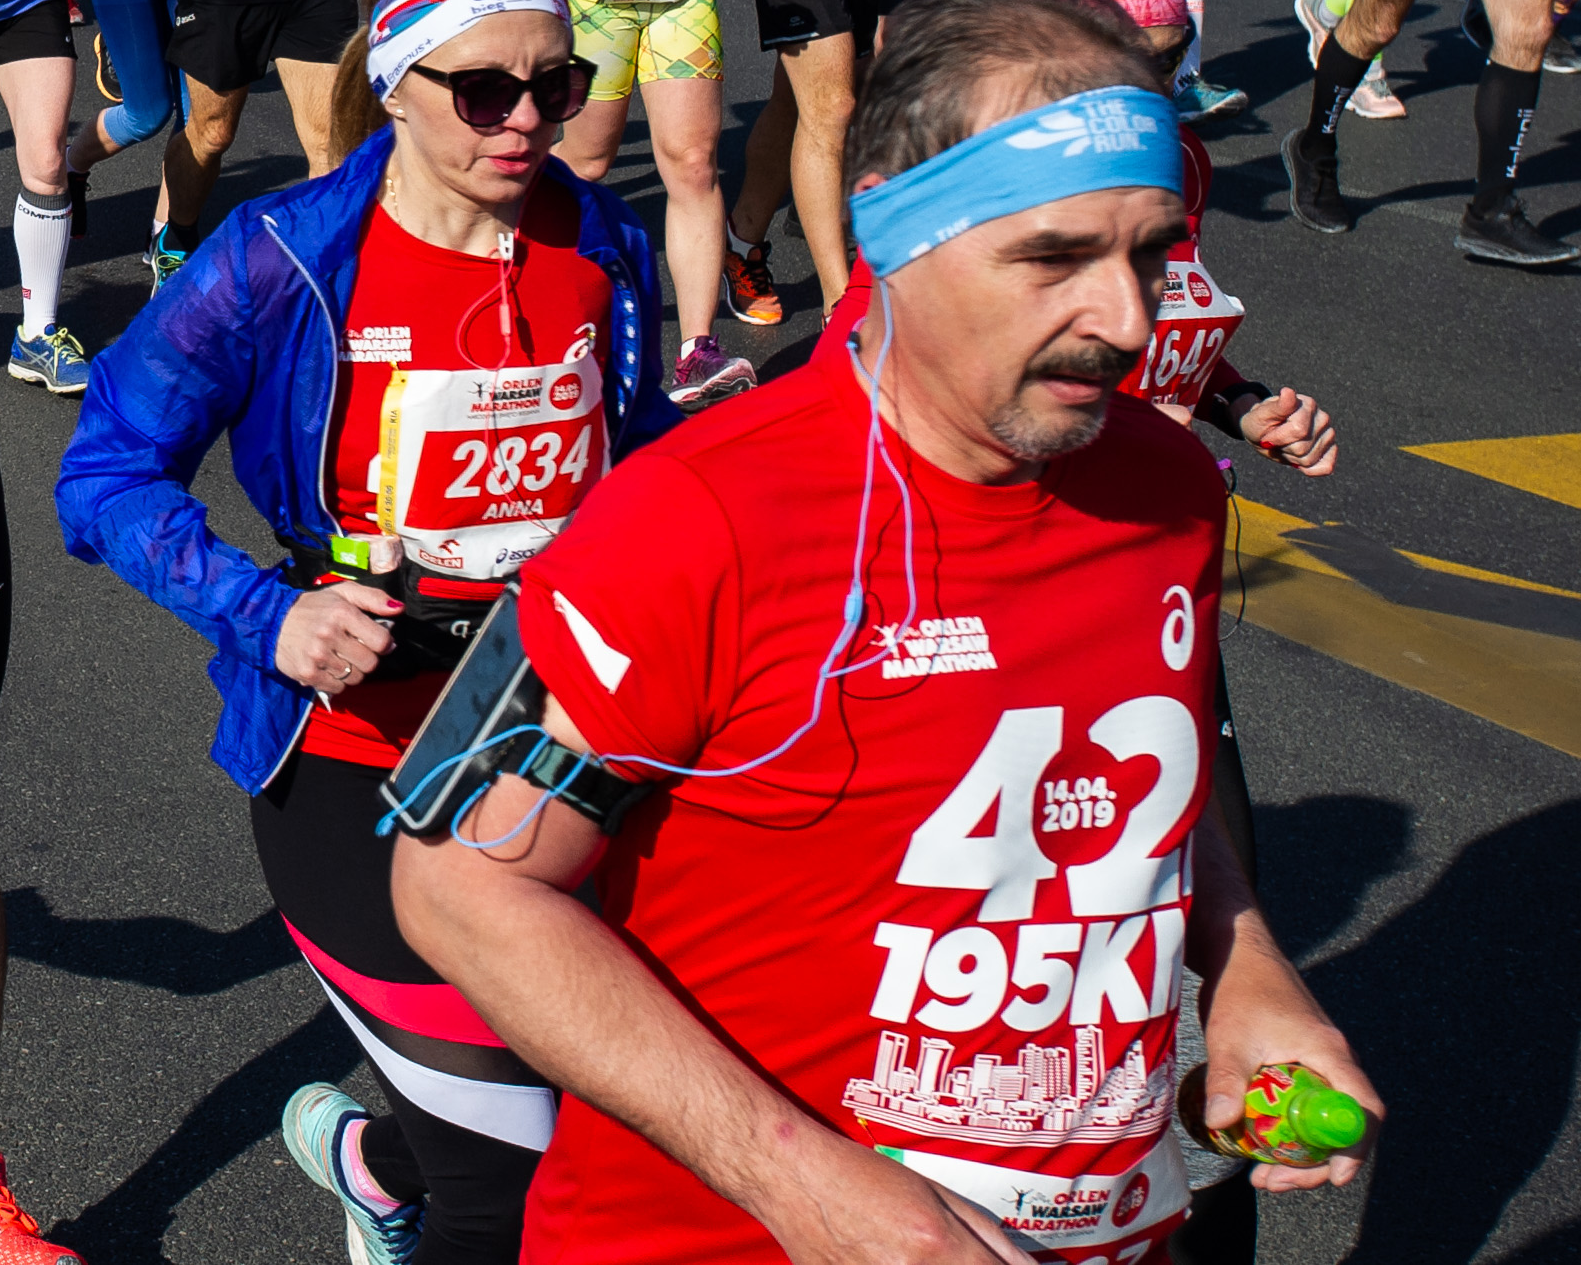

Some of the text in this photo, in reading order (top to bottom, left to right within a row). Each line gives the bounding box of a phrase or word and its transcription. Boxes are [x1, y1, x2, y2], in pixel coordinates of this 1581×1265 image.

[471, 2, 507, 15] bieg
[386, 37, 434, 85] Erasmus+
[1082, 98, 1129, 118] THE
[1088, 114, 1158, 134] COLOR
[18, 203, 67, 221] COMPRE
[362, 326, 411, 340] ORLEN
[348, 338, 412, 351] WARSAW
[502, 377, 543, 390] ORLEN
[489, 387, 543, 401] WARSAW
[471, 398, 541, 413] MARATHON
[444, 424, 592, 499] 2834
[482, 498, 544, 520] ANNA
[421, 551, 463, 568] ORLEN
[920, 616, 985, 637] ORLEN
[904, 633, 990, 659] WARSAW
[881, 651, 998, 680] MARATHON
[1043, 776, 1117, 802] 14.04.
[1042, 799, 1117, 832] 2019
[1054, 1189, 1110, 1206] ORLEN
[1031, 1202, 1108, 1218] WARSAW
[1001, 1215, 1102, 1231] MARATHON
